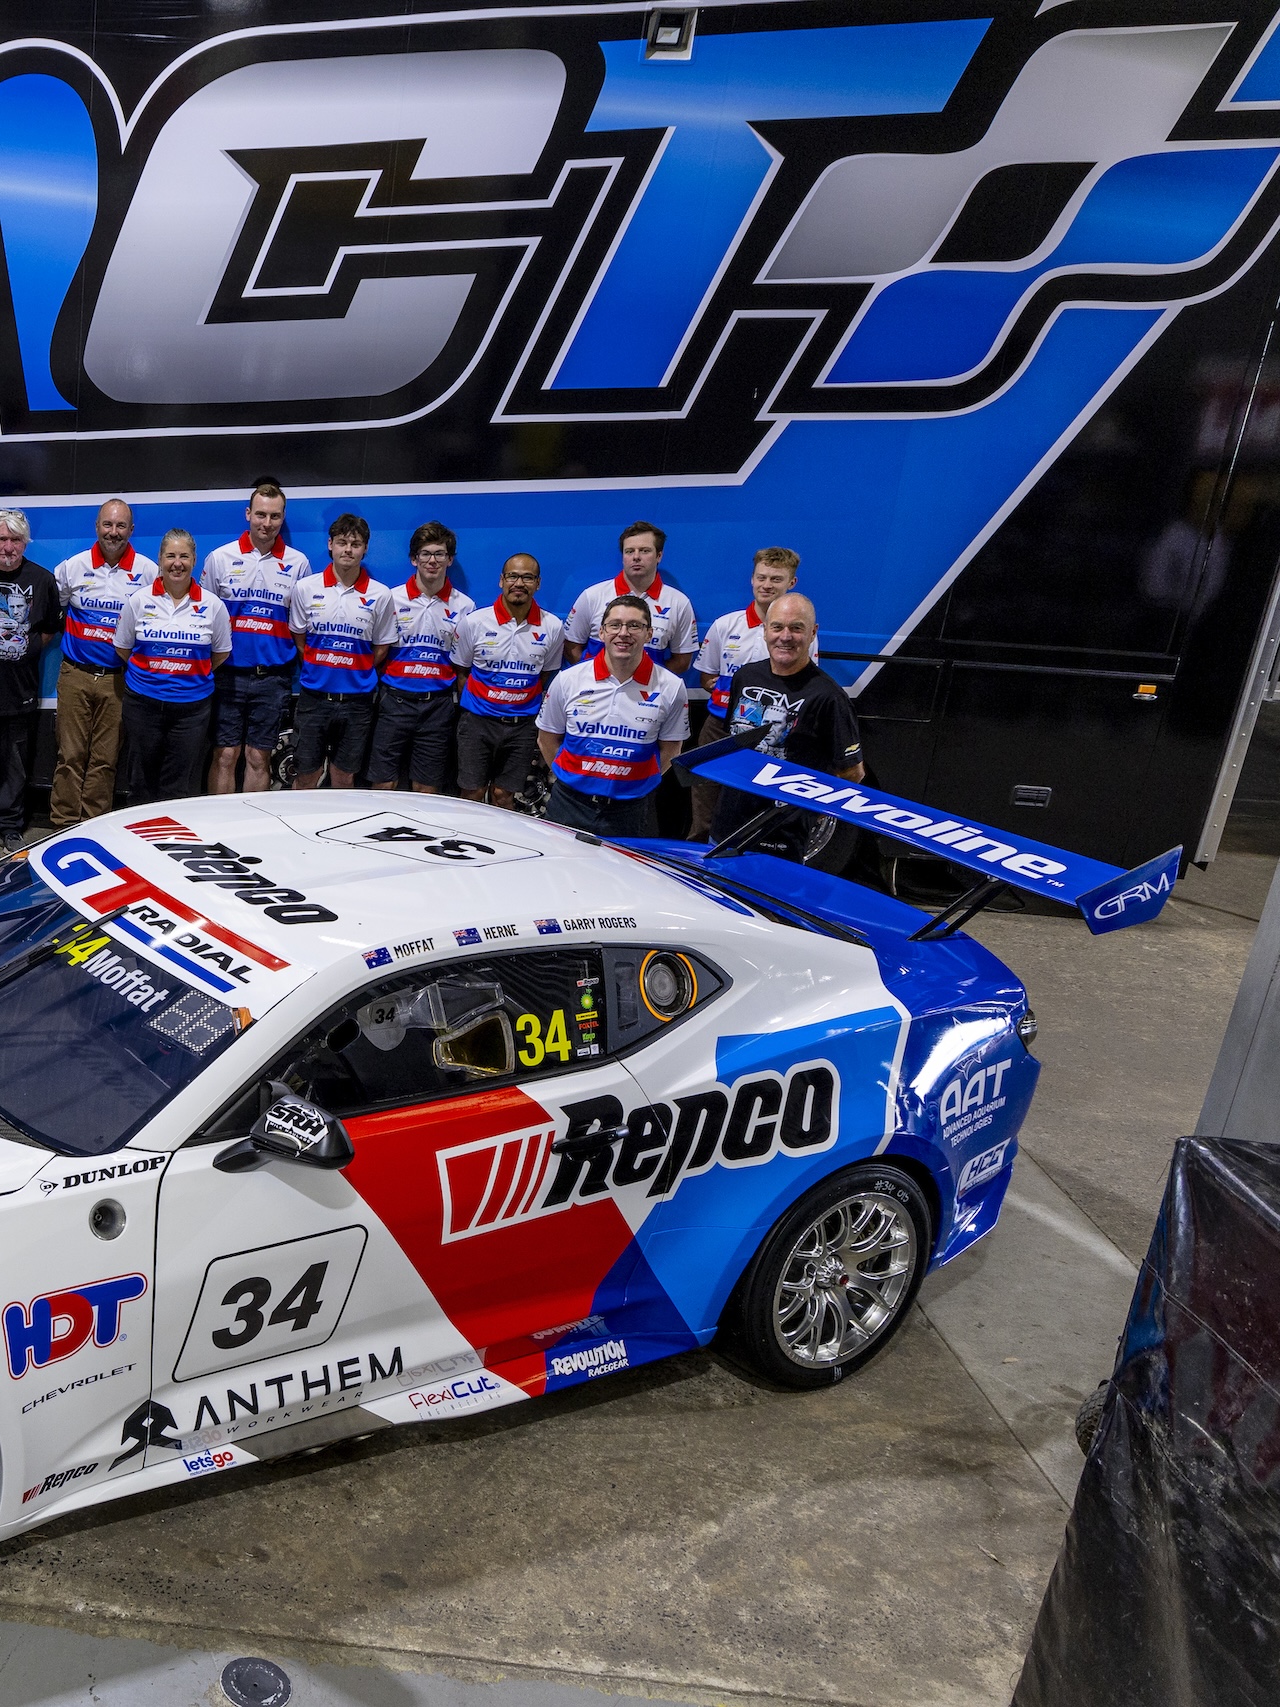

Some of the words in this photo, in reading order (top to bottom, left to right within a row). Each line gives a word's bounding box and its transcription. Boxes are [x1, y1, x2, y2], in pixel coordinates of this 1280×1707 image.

[231, 588, 284, 602] Valvoline
[100, 616, 117, 624] AA
[251, 606, 274, 615] AAT
[143, 629, 201, 641] Valvoline
[244, 619, 274, 631] Repco
[312, 621, 364, 636] Valvoline
[166, 647, 193, 656] AAT
[332, 641, 354, 650] AAT
[419, 652, 441, 660] AAT
[158, 660, 192, 672] Repco
[324, 652, 354, 666] Repco
[486, 660, 537, 672] Valvoline
[505, 678, 529, 687] AAT
[741, 686, 806, 712] GRM
[575, 721, 648, 740] Valvoline
[601, 746, 635, 757] AAT
[592, 760, 632, 776] Repco
[750, 763, 1068, 880] Valvoline
[365, 825, 496, 862] 34
[153, 842, 339, 925] Repco
[1093, 872, 1171, 920] GRM
[483, 924, 519, 940] HERNE
[563, 918, 597, 931] GARRY
[599, 917, 637, 929] ROGERS
[127, 905, 254, 985] RADIAL
[393, 938, 435, 960] MOFFAT
[80, 948, 170, 1013] Moffat
[375, 1007, 395, 1024] 34
[517, 1009, 572, 1067] 34
[940, 1058, 1012, 1126] AAT
[267, 1104, 326, 1139] SRH
[943, 1113, 972, 1140] ADVANCED
[973, 1096, 1007, 1121] AQUARIUM
[541, 1066, 834, 1209] Repco
[62, 1155, 167, 1190] DUNLOP
[875, 1179, 896, 1194] #34
[211, 1260, 329, 1349] 34
[3, 1272, 148, 1379] HDT
[550, 1339, 627, 1377] REVOLUTION
[587, 1358, 629, 1378] RACEGEAR
[21, 1362, 137, 1415] CHEVROLET
[193, 1346, 405, 1431] ANTHEM
[408, 1376, 492, 1409] FlexiCut
[226, 1391, 363, 1434] WORKWEAR
[39, 1462, 98, 1495] Repco
